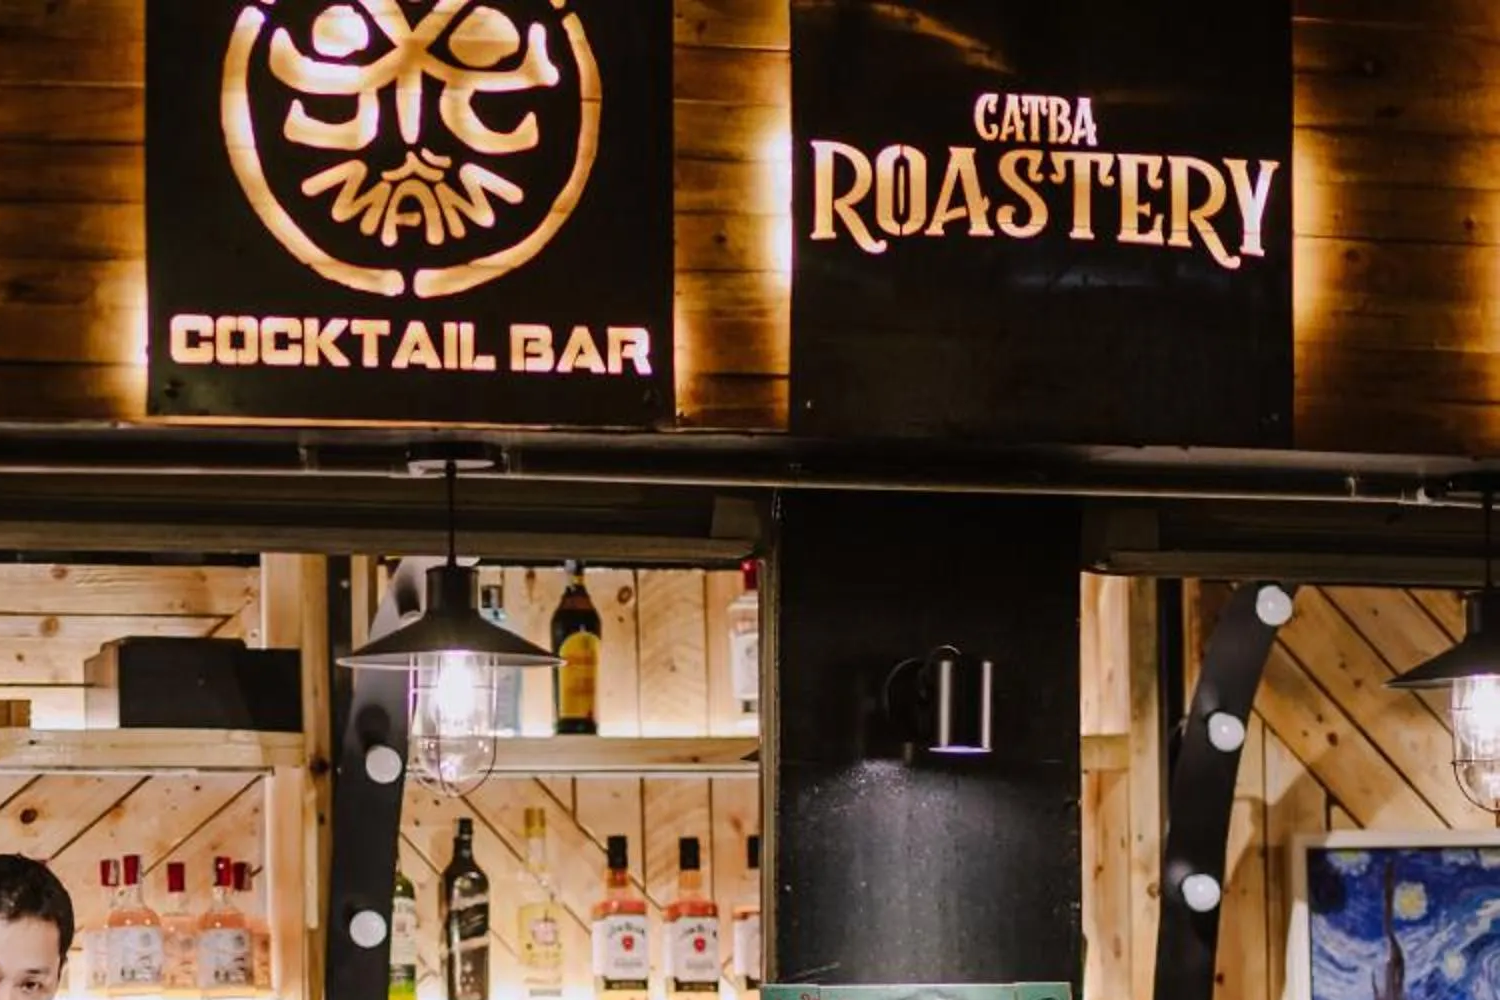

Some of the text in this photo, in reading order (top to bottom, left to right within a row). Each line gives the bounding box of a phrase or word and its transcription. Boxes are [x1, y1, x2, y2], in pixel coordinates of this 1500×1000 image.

[974, 93, 1098, 146] CATBA
[810, 139, 1280, 269] ROASTERY
[170, 313, 652, 376] COCKTAIL BAR
